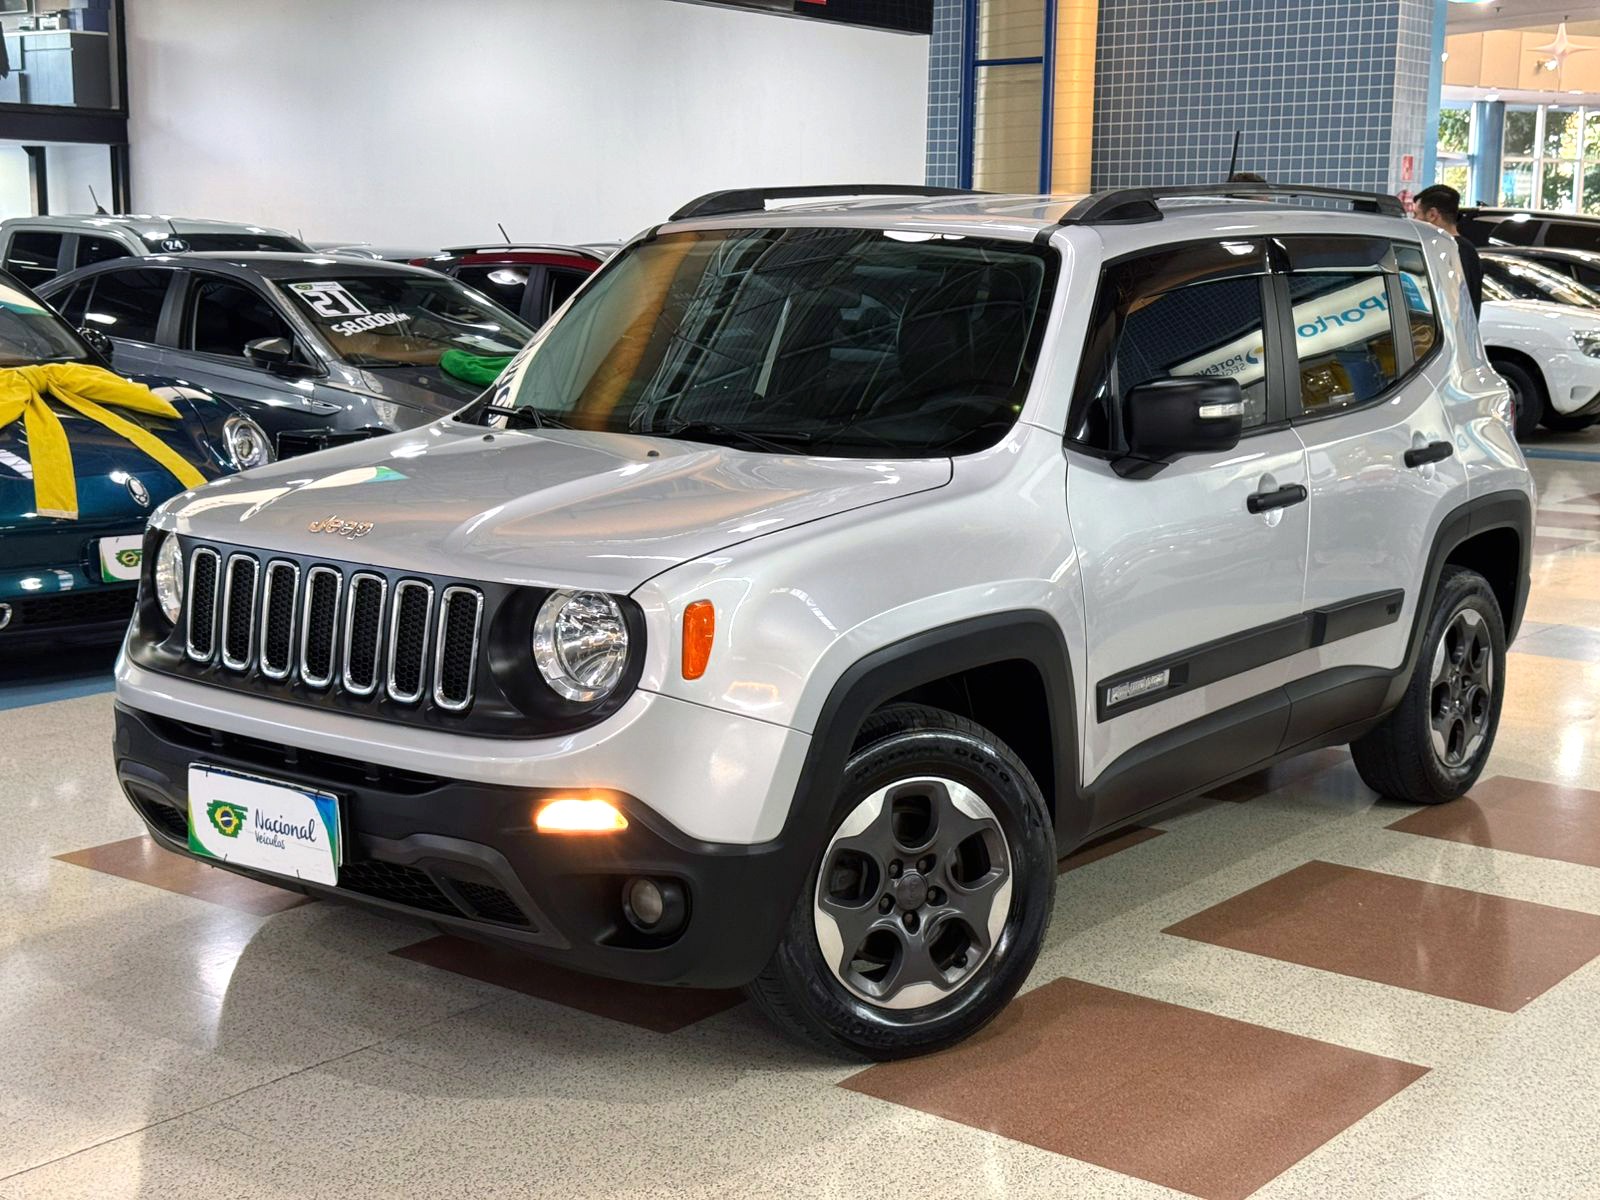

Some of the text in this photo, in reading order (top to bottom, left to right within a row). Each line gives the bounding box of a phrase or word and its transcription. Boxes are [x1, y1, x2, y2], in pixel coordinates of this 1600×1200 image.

[305, 291, 366, 314] 21
[308, 515, 374, 540] Jeep
[255, 808, 317, 843] Nacional
